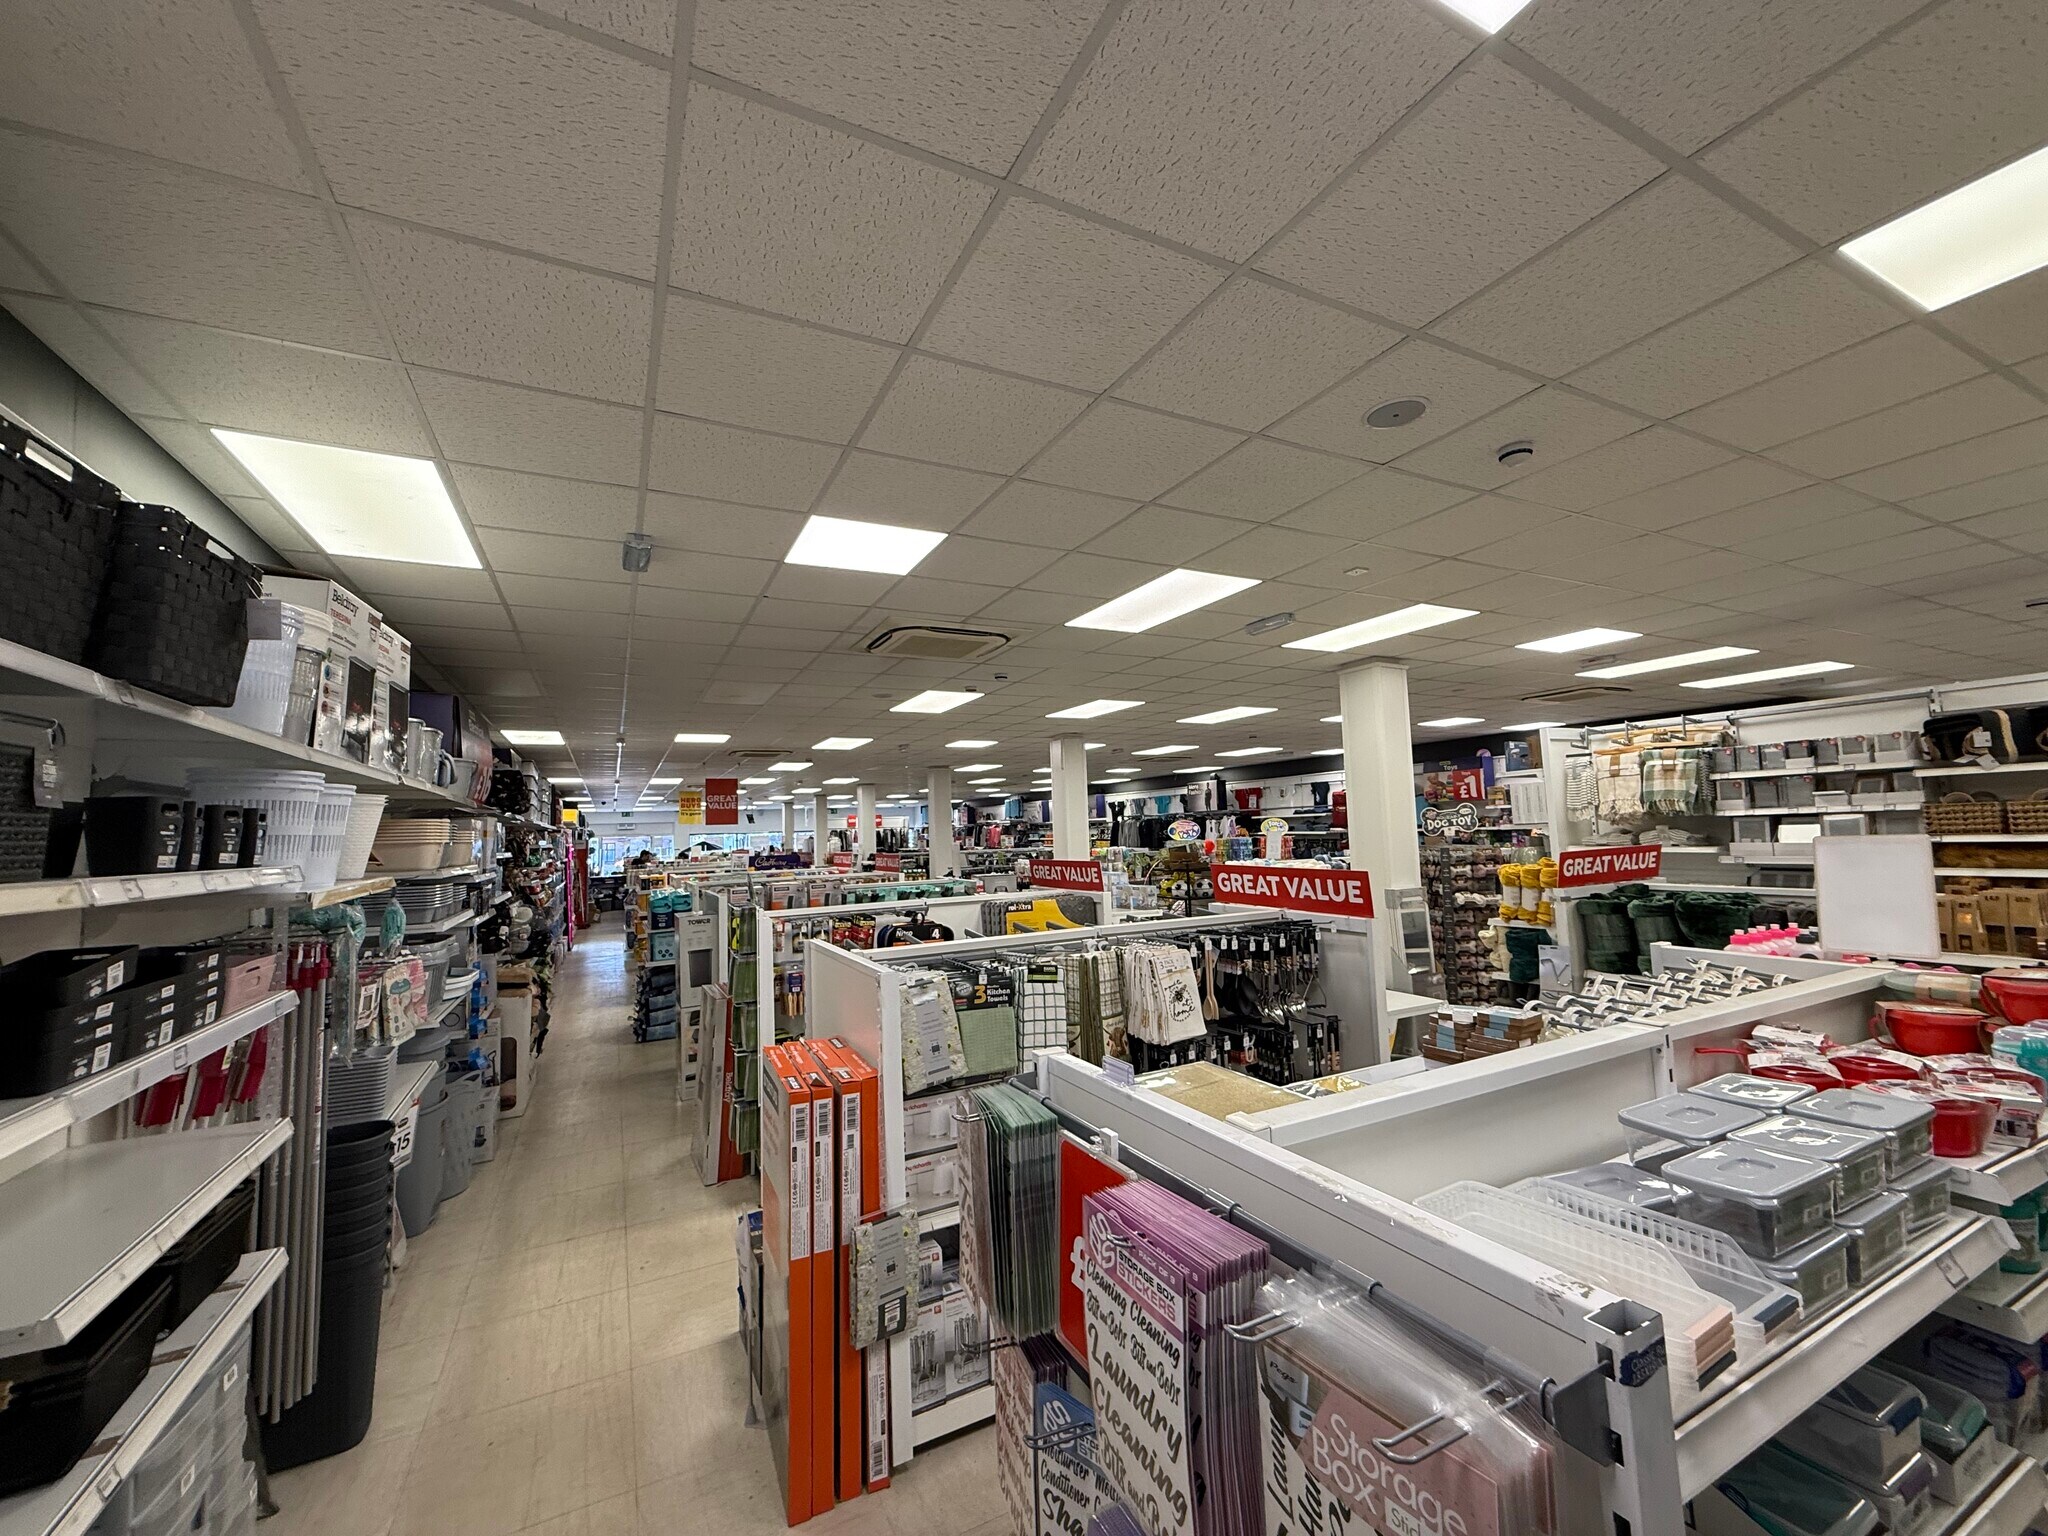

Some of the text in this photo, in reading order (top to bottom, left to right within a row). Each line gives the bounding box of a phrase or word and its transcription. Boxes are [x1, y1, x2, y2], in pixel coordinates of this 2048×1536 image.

[1459, 775, 1478, 798] £1
[1427, 818, 1449, 830] DOG
[1451, 815, 1472, 826] TOY
[1032, 865, 1100, 883] GREAT VALUE
[1563, 851, 1658, 877] GREAT VALUE
[1217, 873, 1364, 904] GREAT VALUE
[931, 928, 940, 940] 4
[974, 985, 987, 1005] 3
[987, 986, 1011, 996] Kitchen
[987, 995, 1009, 1003] Towels
[1118, 1250, 1176, 1306] STORAGE BOX
[1117, 1263, 1176, 1322] STICKERS
[1086, 1258, 1181, 1370] Cleaning Cleaning
[1269, 1360, 1300, 1384] Pegs
[1087, 1322, 1183, 1465] Laundry
[1093, 1377, 1188, 1528] Cleaning
[1330, 1413, 1467, 1536] Storage
